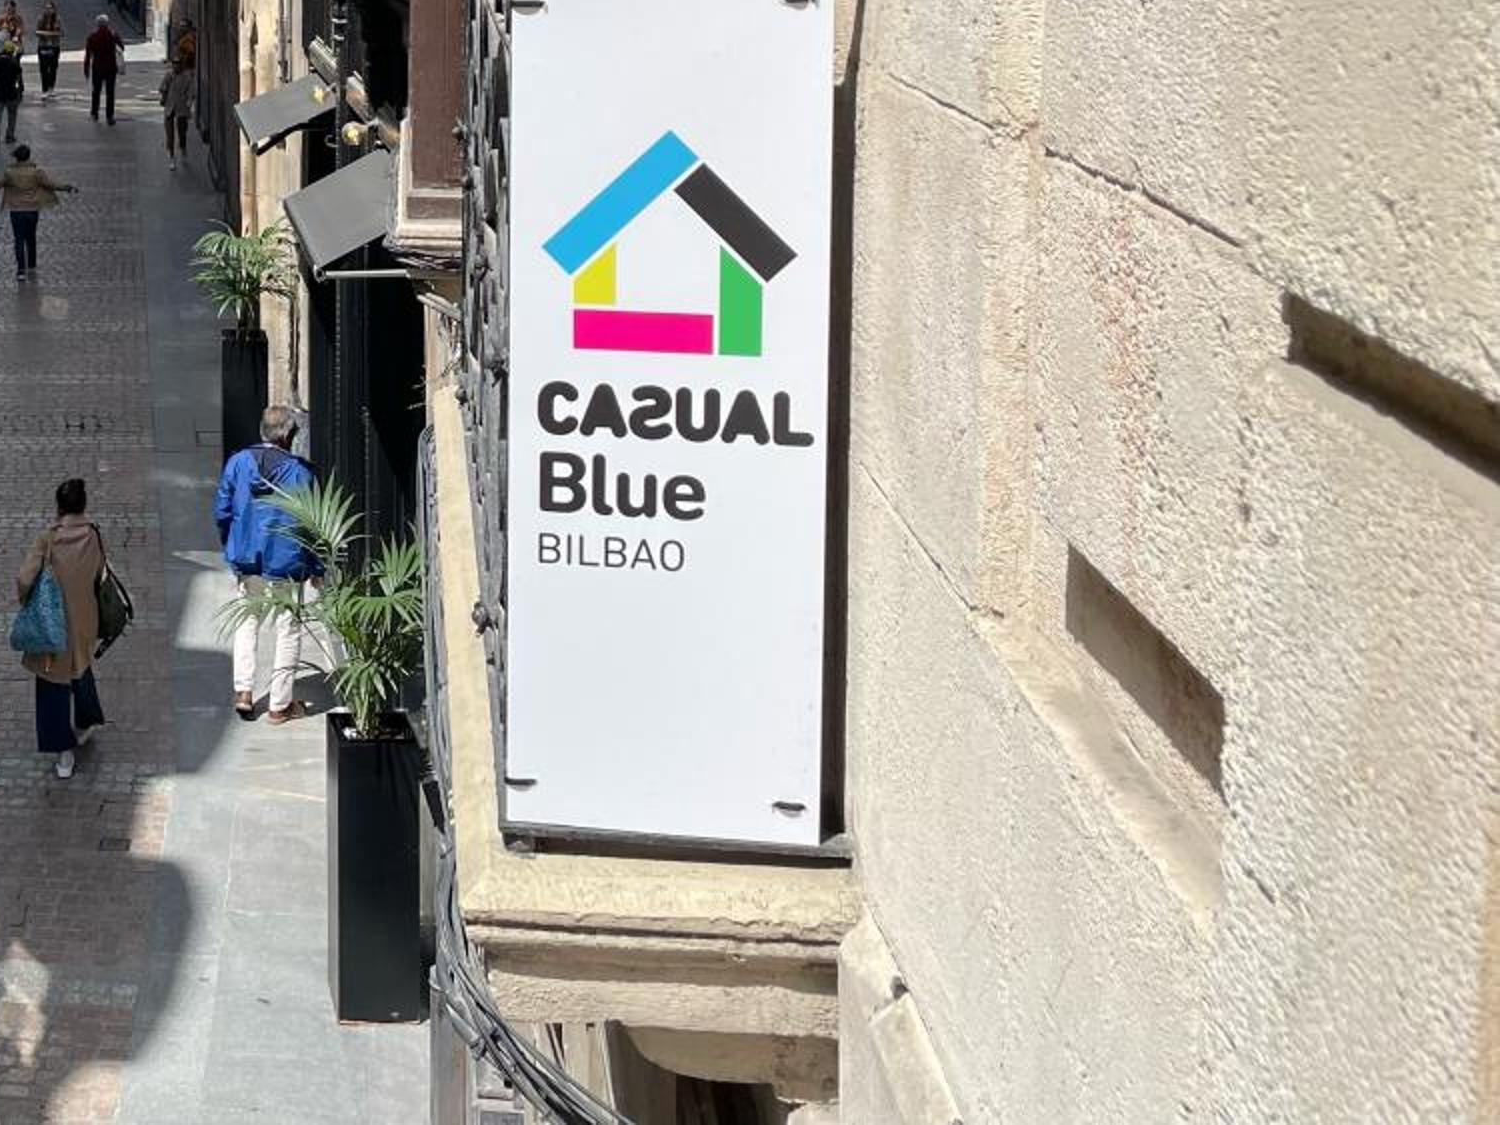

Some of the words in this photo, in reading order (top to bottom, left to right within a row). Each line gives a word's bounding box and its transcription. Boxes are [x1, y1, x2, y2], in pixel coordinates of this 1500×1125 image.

[537, 380, 815, 447] CASUAL
[539, 451, 706, 521] Blue
[538, 532, 685, 572] BILBAO
